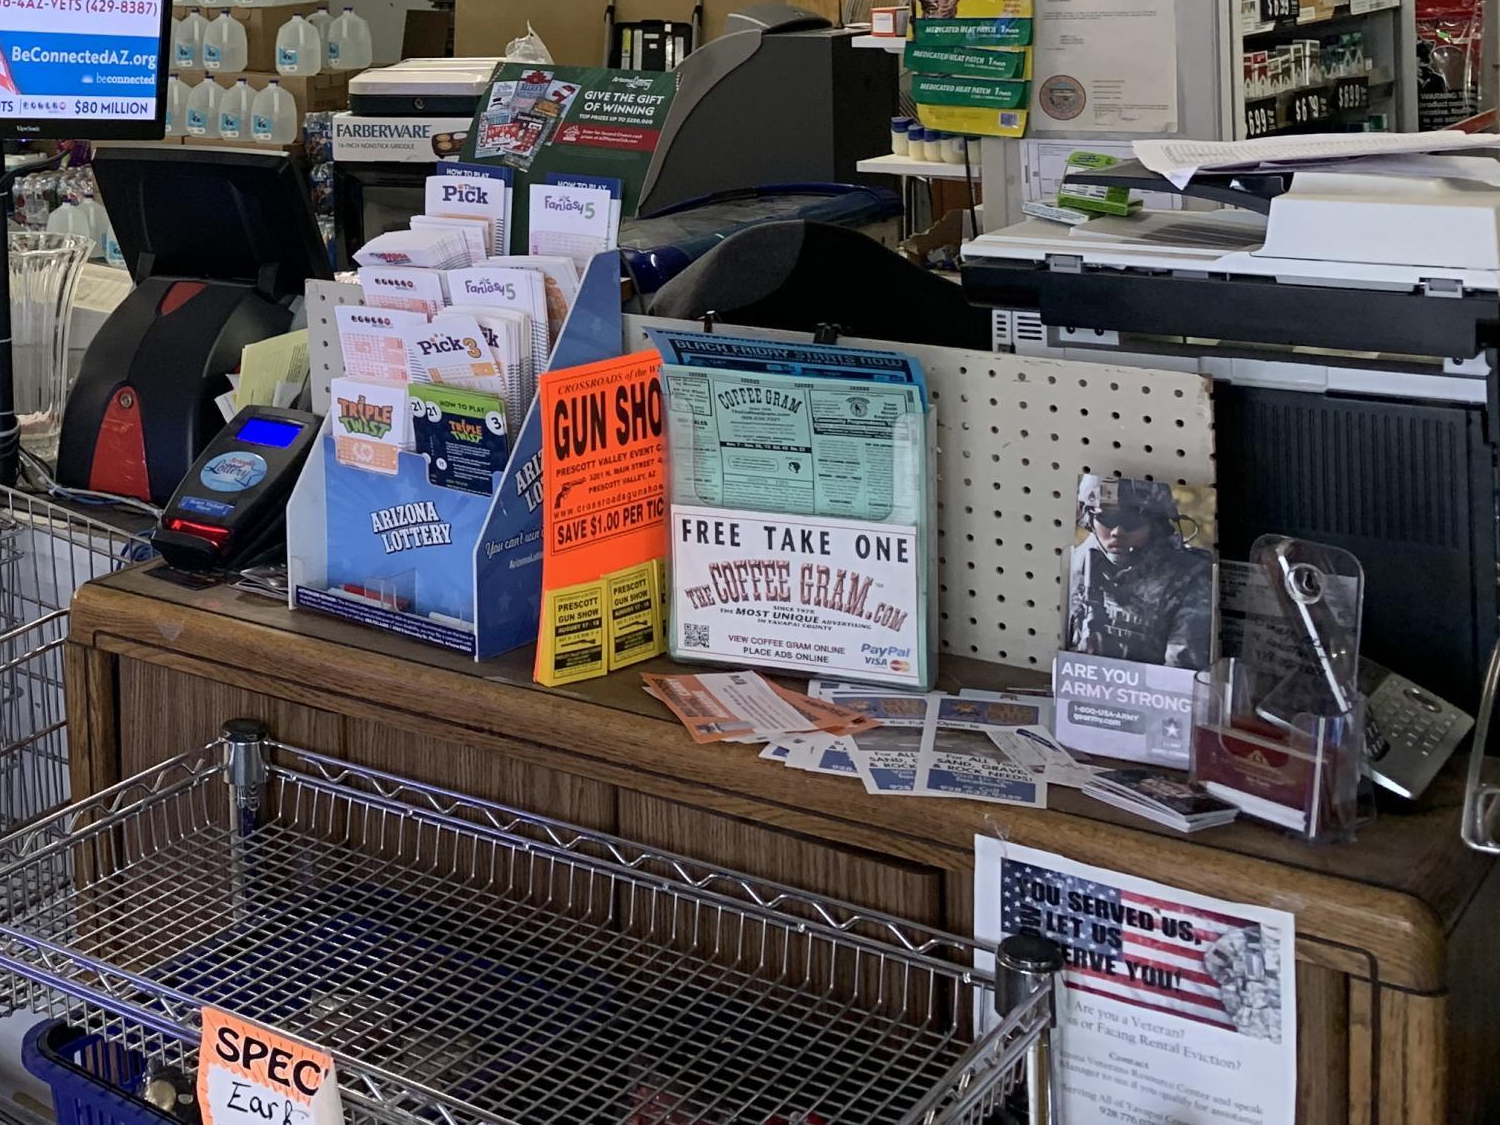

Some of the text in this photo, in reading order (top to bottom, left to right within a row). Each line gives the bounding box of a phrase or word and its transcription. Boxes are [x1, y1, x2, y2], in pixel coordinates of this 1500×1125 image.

[85, 0, 157, 17] (429-8387)
[11, 45, 157, 69] BeConnectedAZ.org
[95, 72, 155, 86] beconnected
[584, 90, 665, 105] GIVE THE GIFT
[74, 99, 98, 115] $80
[100, 101, 148, 115] MILLION
[584, 101, 655, 116] OF WINNING
[336, 123, 432, 139] FARBERWARE
[360, 142, 389, 150] NONSTICK
[442, 184, 489, 205] Pick
[463, 183, 476, 191] The
[544, 195, 596, 220] Fantasy 5
[465, 278, 516, 301] Fantasy 5
[417, 334, 482, 359] Pick 3
[557, 368, 647, 396] CROSSROADS of the
[337, 394, 393, 424] TRIPLE
[411, 401, 423, 412] 21
[439, 400, 485, 414] HOW TO PLAY
[717, 387, 803, 414] COFFEE GRAM
[426, 406, 438, 418] 21
[554, 390, 607, 461] GUN
[615, 377, 663, 447] SHO
[338, 416, 393, 440] TWIST
[449, 420, 483, 435] TRIPLE
[491, 416, 502, 430] 3
[451, 431, 483, 444] TWIST
[556, 446, 654, 478] PRESCOTT VALLEY EVENT
[613, 461, 652, 476] MAIN STREET
[588, 479, 621, 494] PRESCOTT
[369, 500, 440, 535] ARIZONA
[557, 496, 664, 546] SAVE $1.00 PER TIC
[380, 523, 453, 556] LOTTERY
[682, 518, 909, 564] FREE TAKE ONE
[613, 578, 647, 595] PRESCOTT
[685, 584, 717, 610] THE
[708, 558, 791, 605] COFFEE
[557, 597, 599, 613] PRESCOTT
[614, 590, 648, 606] GUN SHOW
[558, 608, 599, 624] GUN SHOW
[773, 604, 794, 612] SINCE
[735, 607, 770, 618] MOST
[772, 612, 820, 625] UNIQUE
[821, 619, 872, 631] ADVERTISING
[802, 623, 833, 632] COUNTY
[557, 623, 581, 634] AUGUST
[728, 633, 846, 655] VIEW COFFEE GRAM ONLINE
[860, 642, 911, 659] PayPal
[743, 646, 829, 664] PLACE ADS ONLINE
[864, 656, 888, 667] VISA
[1060, 661, 1140, 686] ARE YOU
[1060, 679, 1192, 714] ARMY STRONG
[1073, 704, 1140, 722] 1-800-USA-ARMY
[947, 766, 982, 775] ROCK
[1017, 878, 1204, 946] YOU SERVED US,
[1046, 910, 1123, 949] LET US
[1061, 944, 1184, 993] ERVE YOU!
[1074, 1000, 1186, 1040] Are you a Veteran?
[1097, 1022, 1242, 1071] Facing Rental Eviction?
[1212, 1094, 1232, 1107] and
